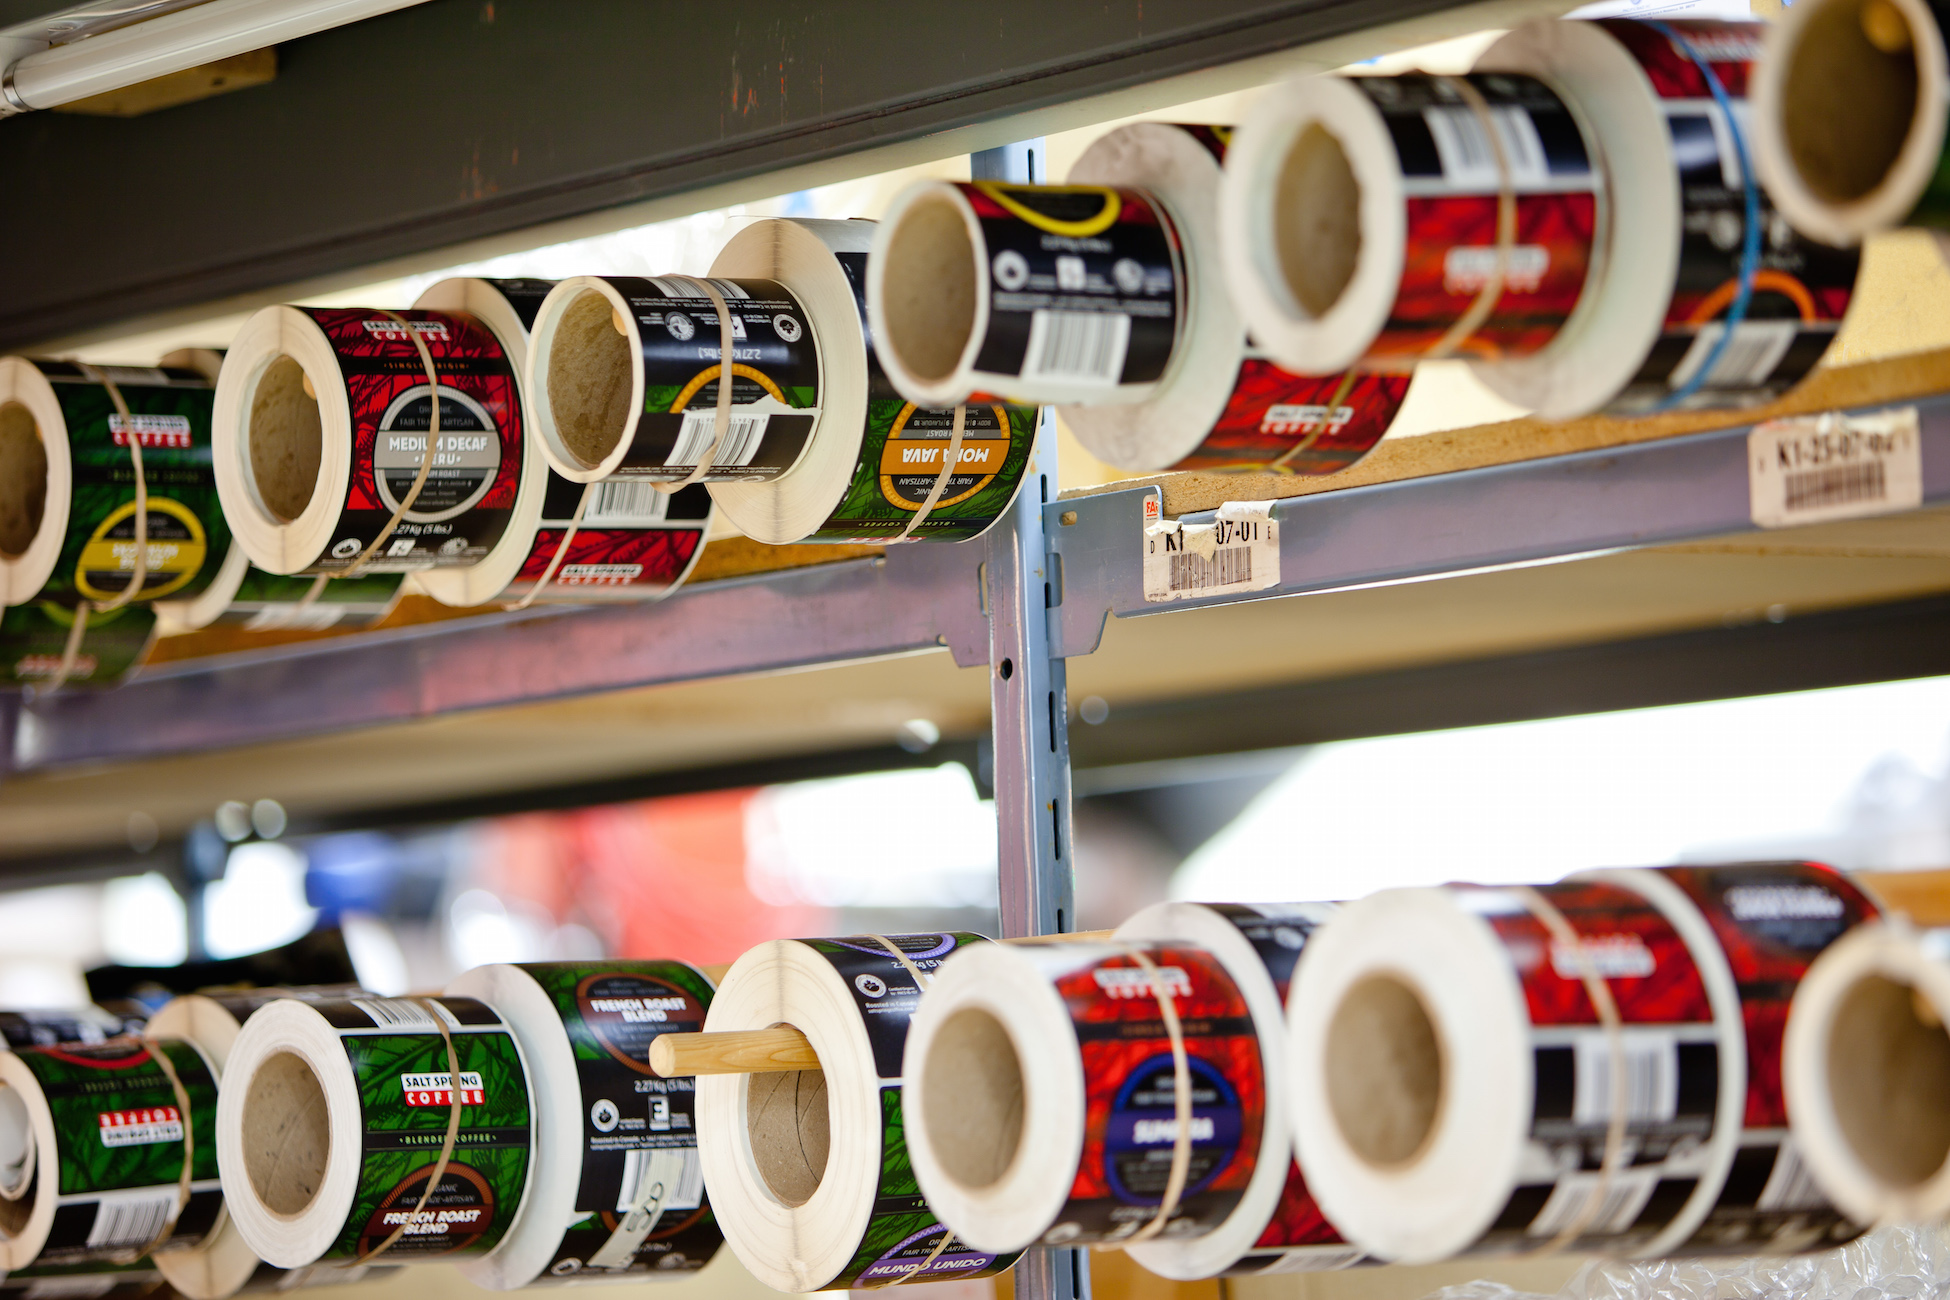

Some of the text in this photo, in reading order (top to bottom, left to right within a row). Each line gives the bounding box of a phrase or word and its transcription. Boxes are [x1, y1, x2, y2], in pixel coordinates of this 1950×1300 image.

[373, 332, 450, 342] COFEE
[432, 362, 465, 371] RIGIN
[419, 405, 453, 414] ORNIC
[925, 429, 949, 438] ROAST
[447, 436, 488, 451] DECAF
[901, 447, 939, 463] JAVA
[956, 477, 974, 486] FAIR
[914, 487, 949, 496] OANIC
[590, 997, 687, 1013] FRENCH ROAST
[621, 1009, 668, 1023] BLEND
[406, 1075, 478, 1087] SALT SPNG
[407, 1090, 484, 1106] COFFEE
[455, 1133, 491, 1144] COFFEE
[424, 1184, 458, 1194] GANIC
[436, 1210, 482, 1223] ROAST
[403, 1222, 449, 1235] BLEND
[928, 1236, 962, 1246] ORNIC
[902, 1248, 921, 1257] FAIR
[868, 1257, 987, 1276] MUNDO UNIDO
